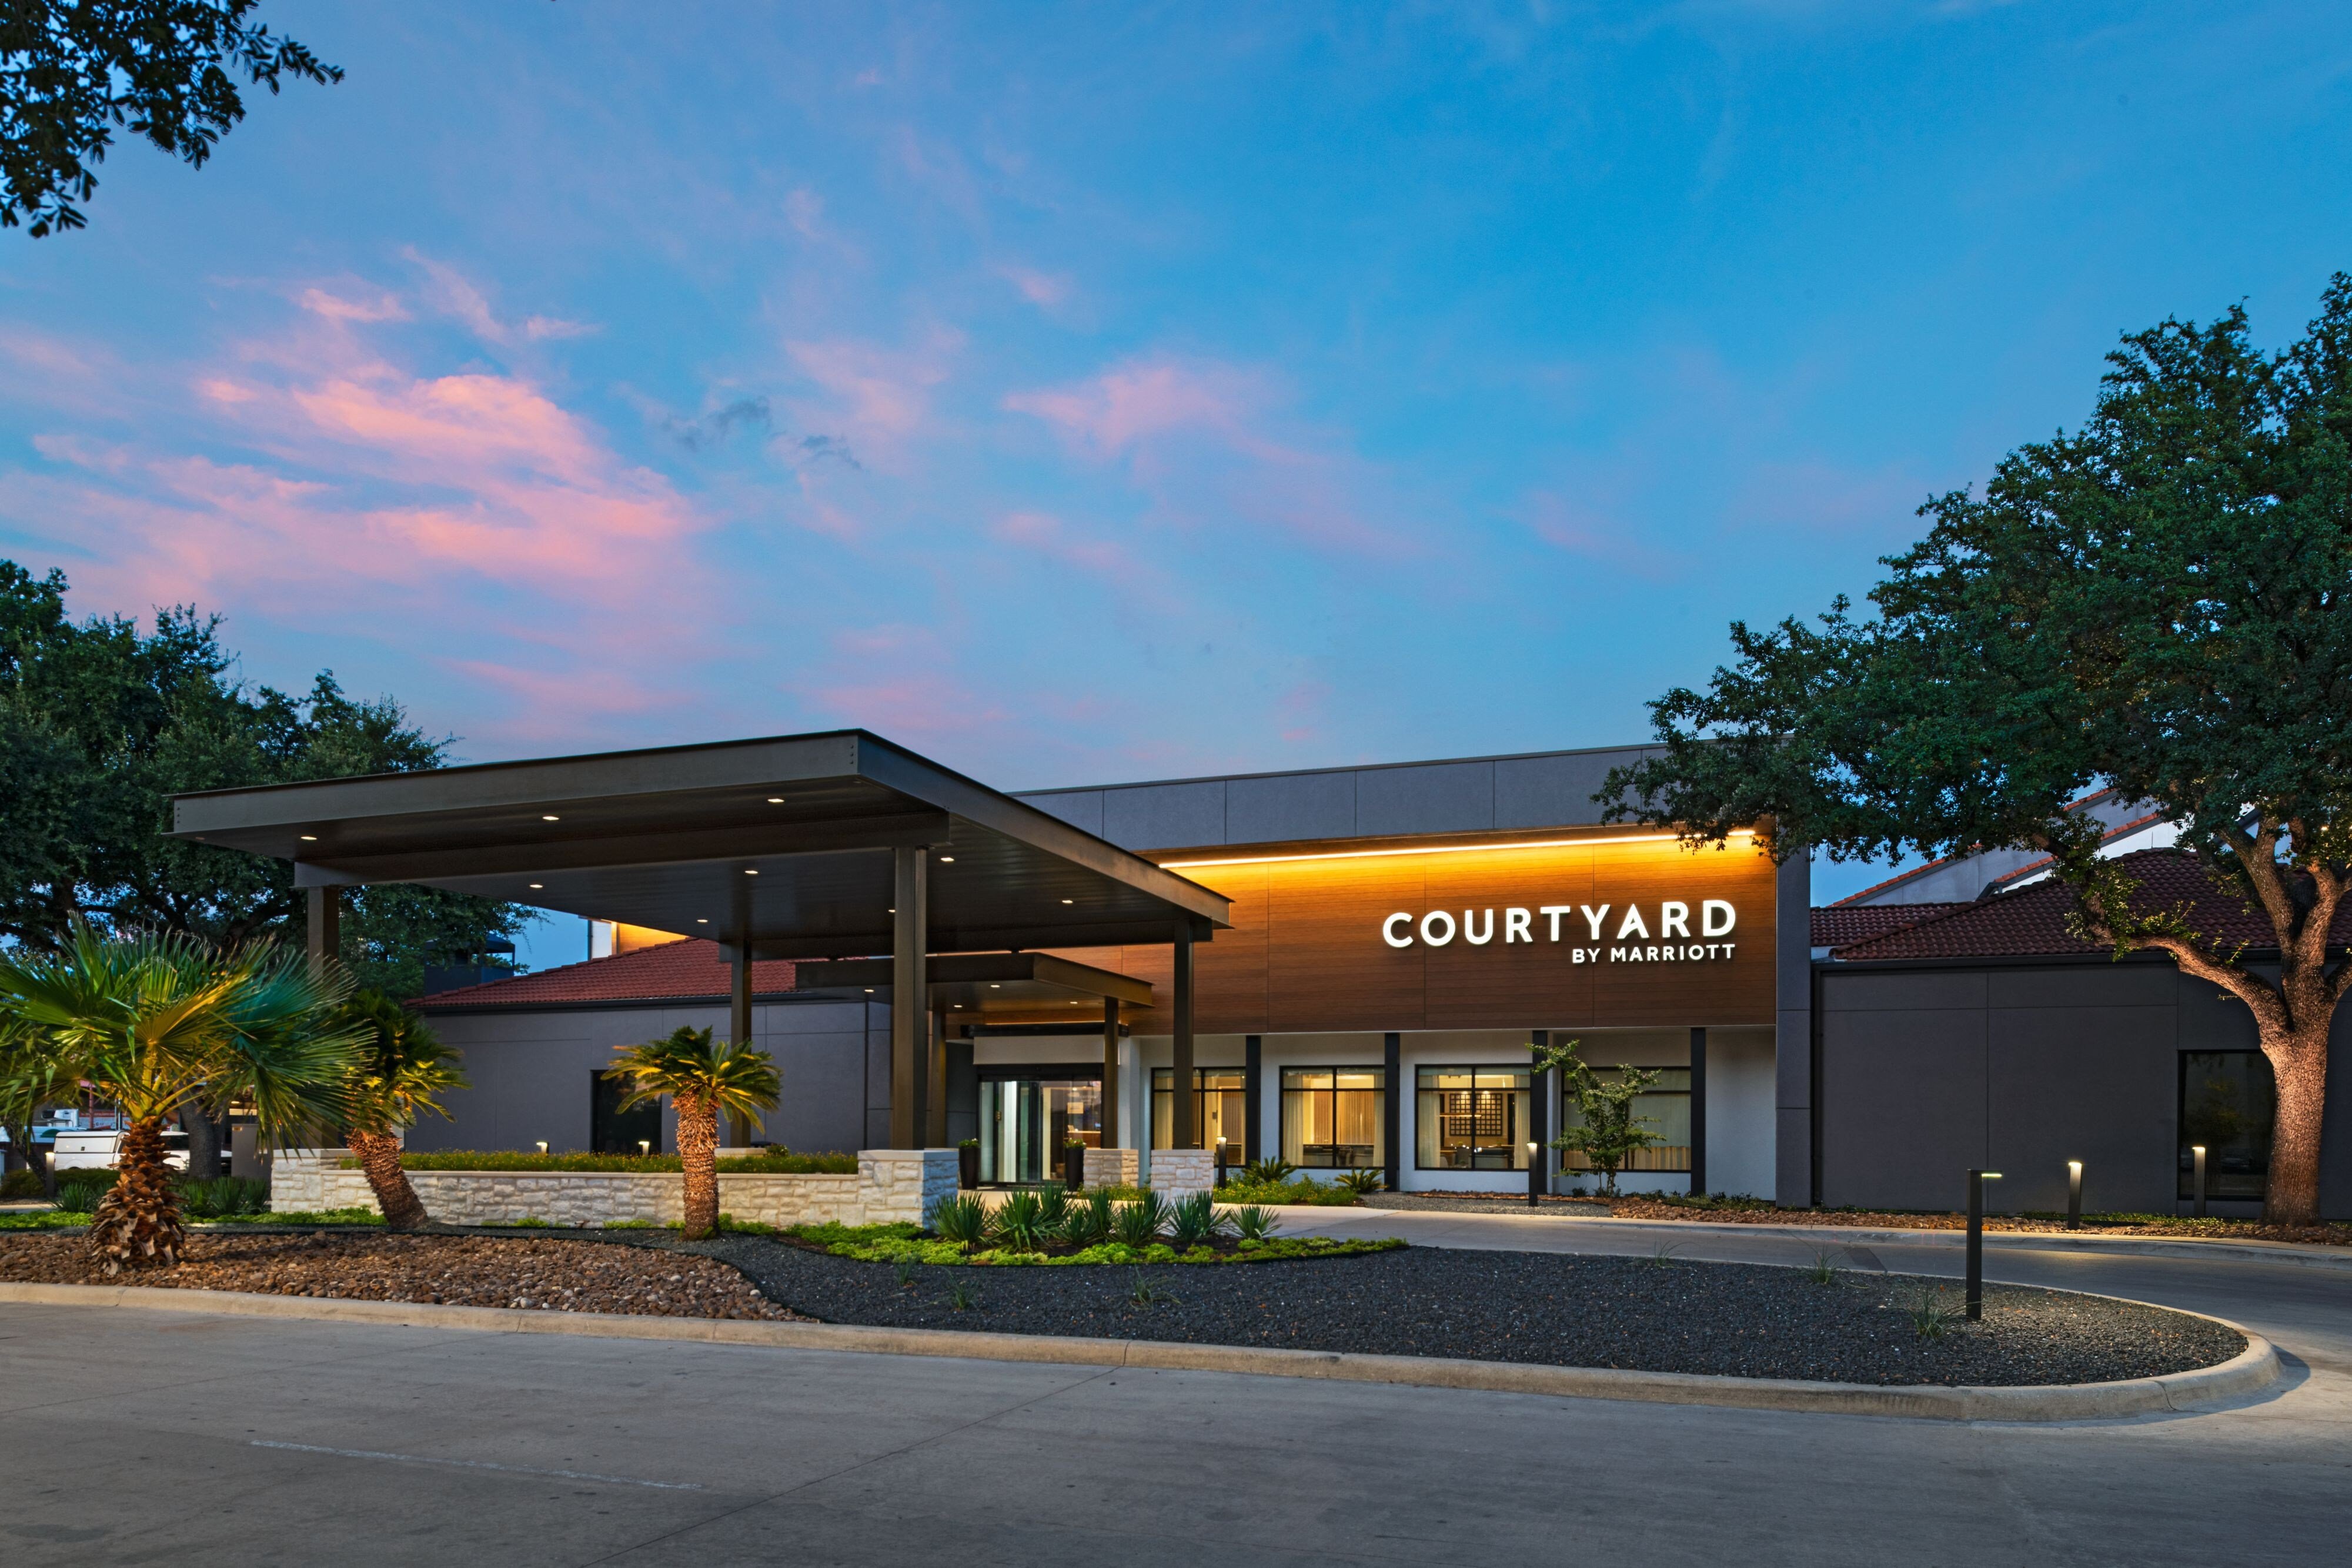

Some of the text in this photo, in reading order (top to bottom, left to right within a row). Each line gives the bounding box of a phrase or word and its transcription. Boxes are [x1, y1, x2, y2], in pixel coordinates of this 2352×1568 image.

[1382, 900, 1736, 948] COURTYARD
[1572, 944, 1735, 964] BY MARRIOTT
